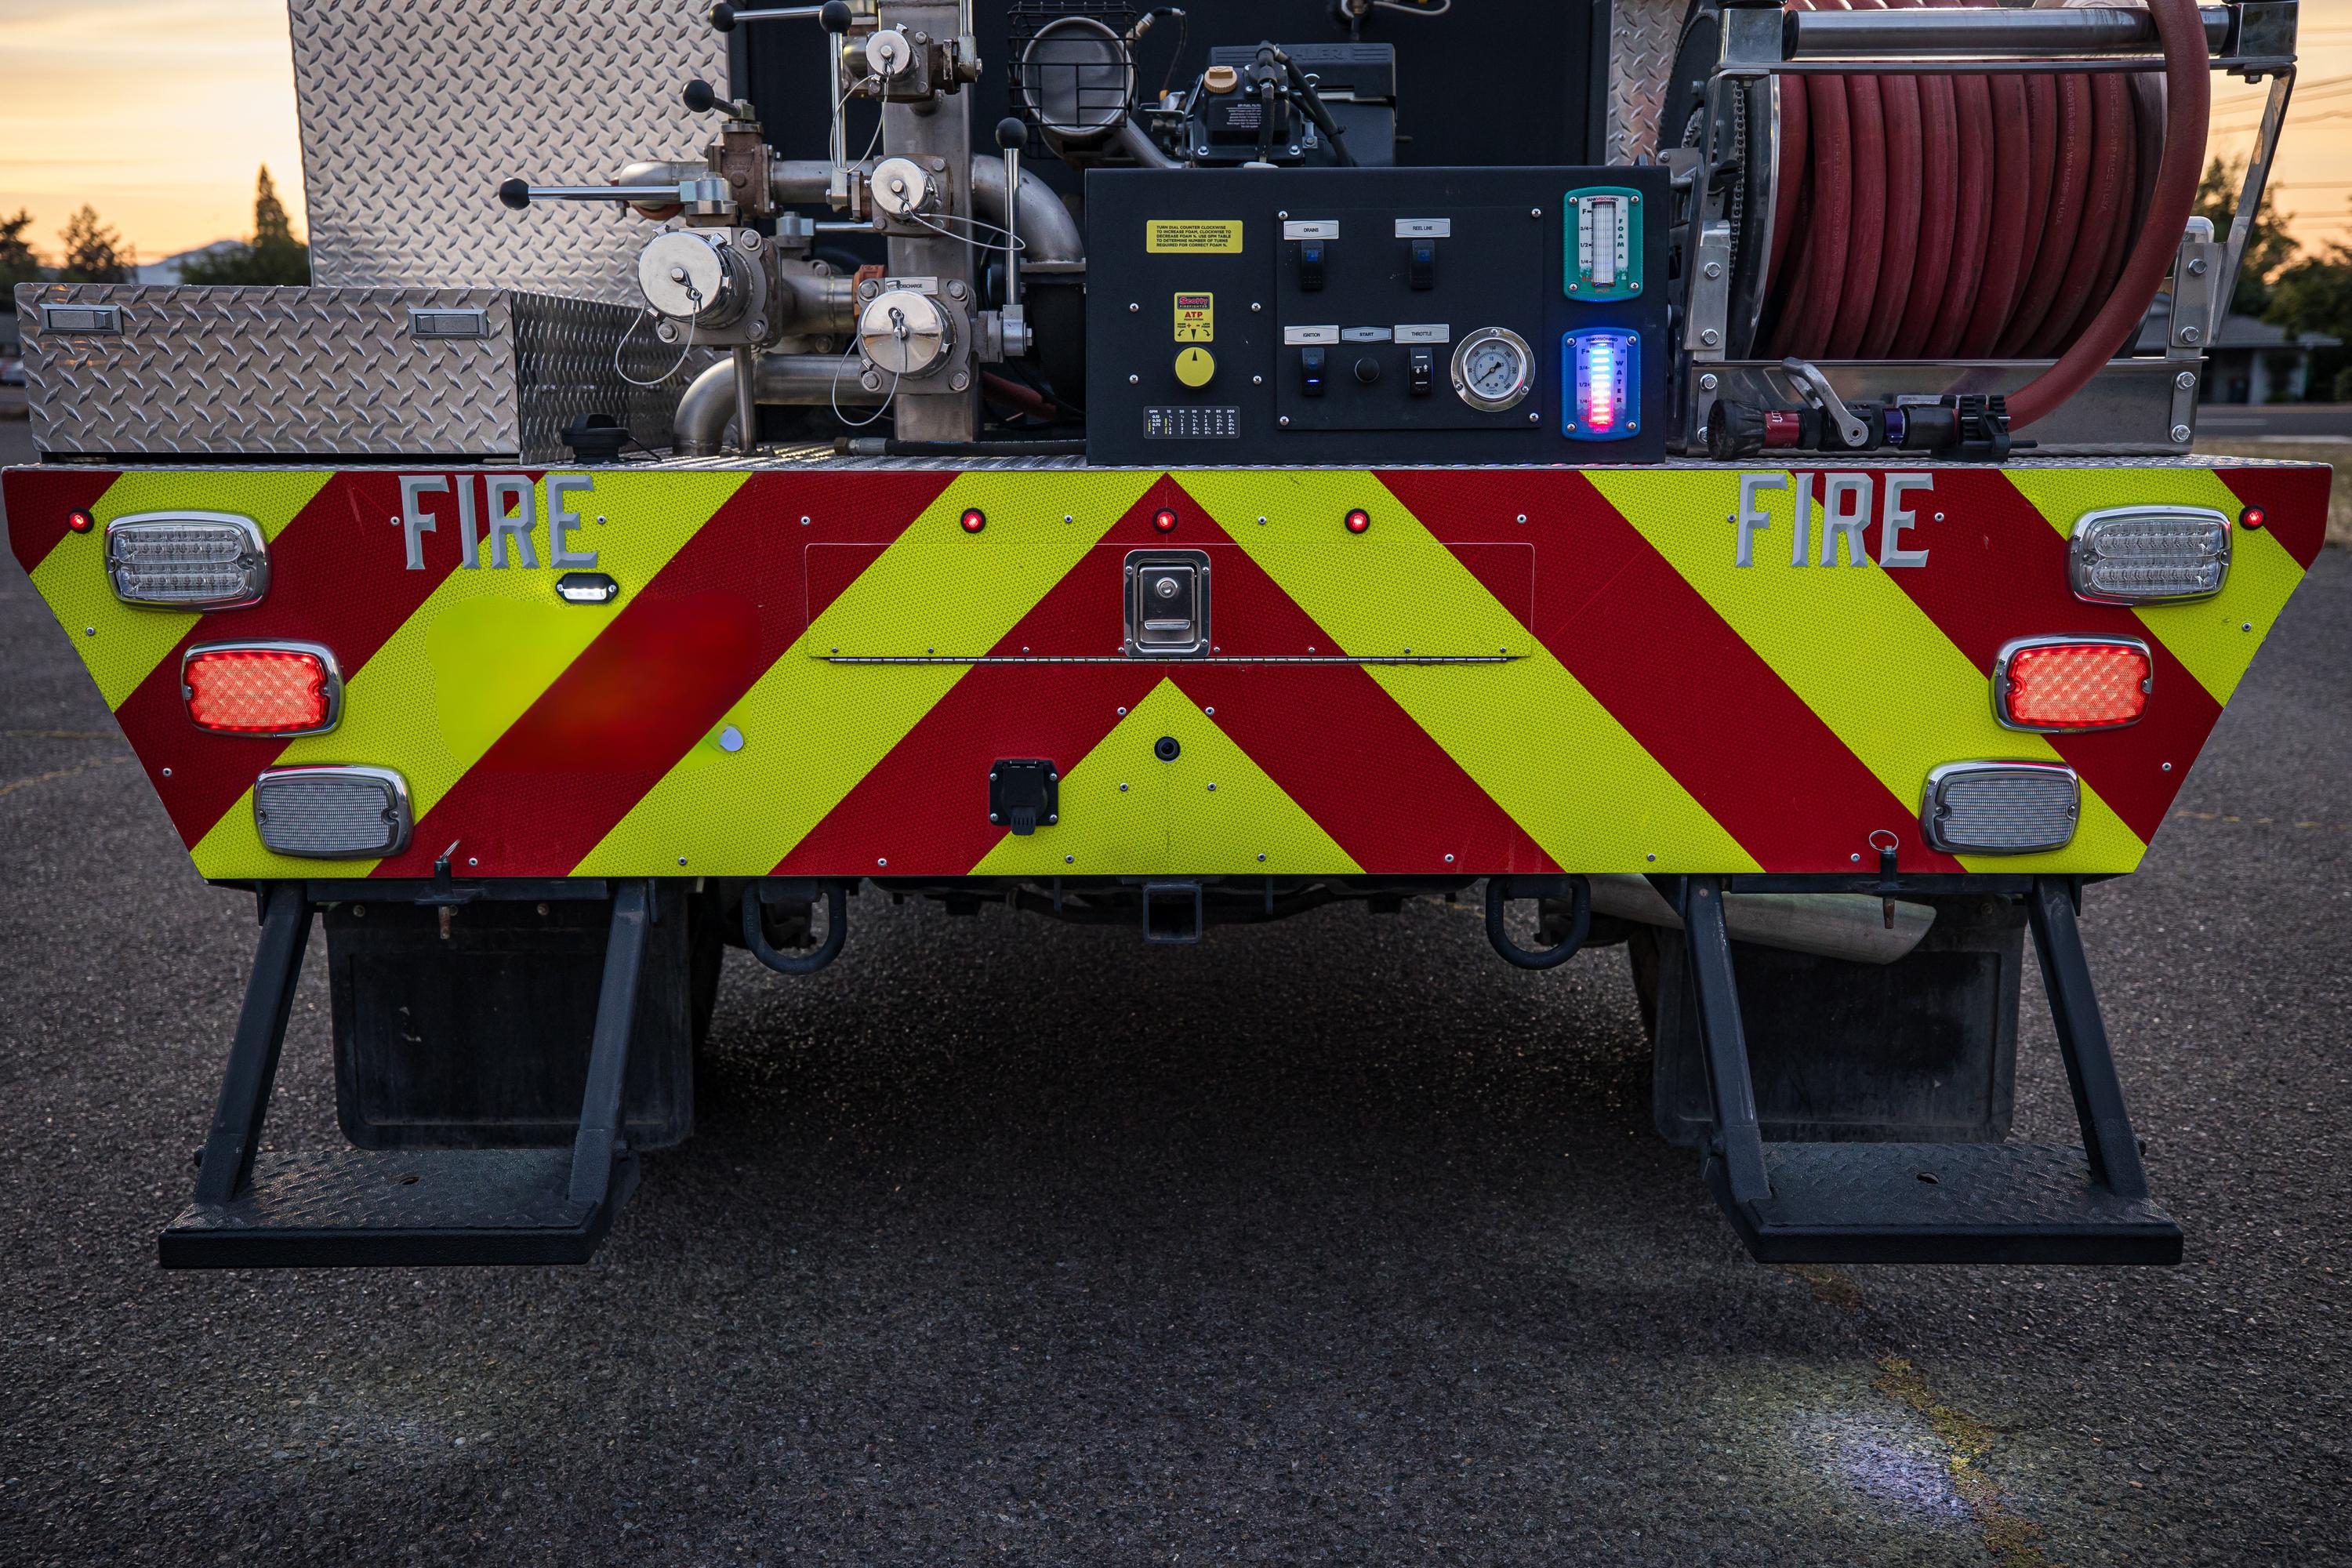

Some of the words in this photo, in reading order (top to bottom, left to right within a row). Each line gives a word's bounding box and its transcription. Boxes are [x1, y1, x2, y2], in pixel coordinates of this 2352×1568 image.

[2066, 81, 2075, 118] BOOSTER
[2060, 169, 2071, 195] MADE
[2055, 207, 2065, 225] USA
[1615, 361, 1624, 403] WATER
[398, 475, 598, 570] FIRE
[1735, 473, 1934, 568] FIRE
